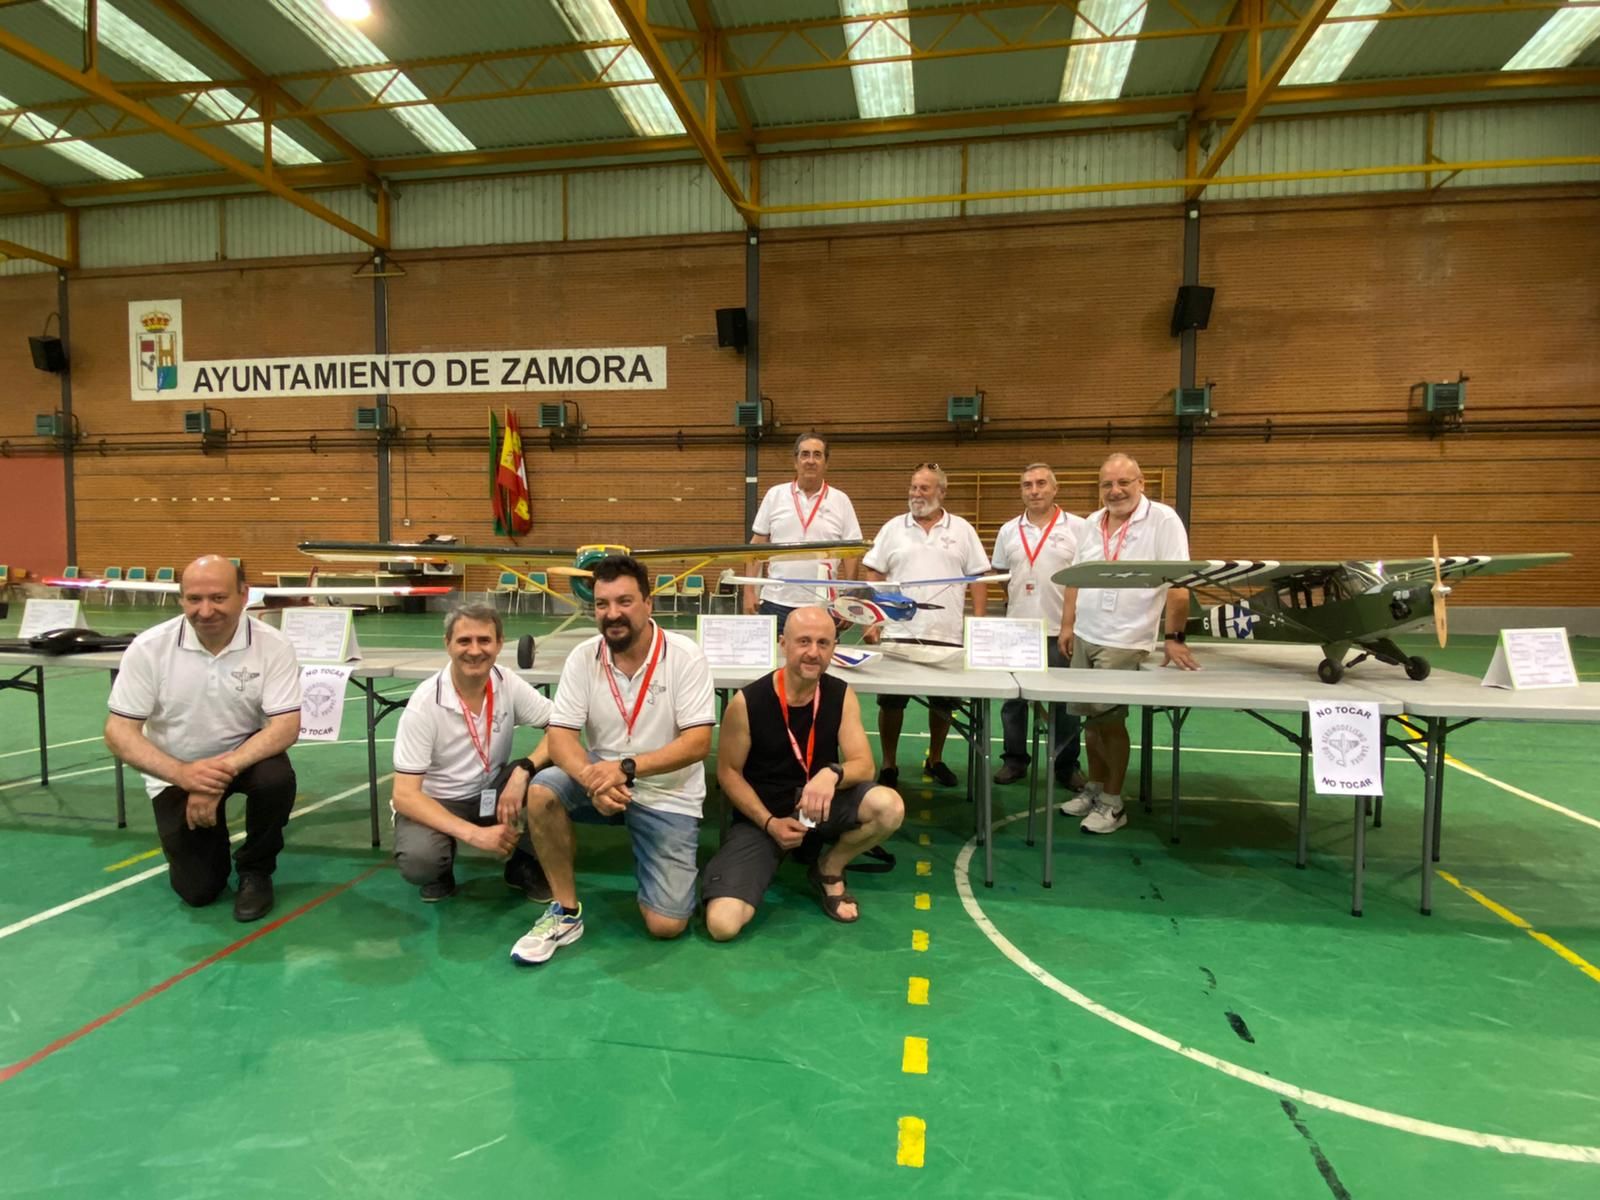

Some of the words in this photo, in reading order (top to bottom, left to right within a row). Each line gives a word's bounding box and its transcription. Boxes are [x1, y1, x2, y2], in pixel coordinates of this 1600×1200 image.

[193, 359, 436, 393] AYUNTAMIENTO
[446, 358, 490, 387] DE
[500, 354, 653, 386] ZAMORA
[305, 669, 318, 678] NO
[320, 668, 345, 678] TOCAR
[1316, 707, 1332, 718] NO
[1335, 706, 1372, 719] TOCAR
[309, 726, 333, 736] TOCAR
[1322, 776, 1337, 787] NO
[1339, 778, 1373, 789] TOCAR
